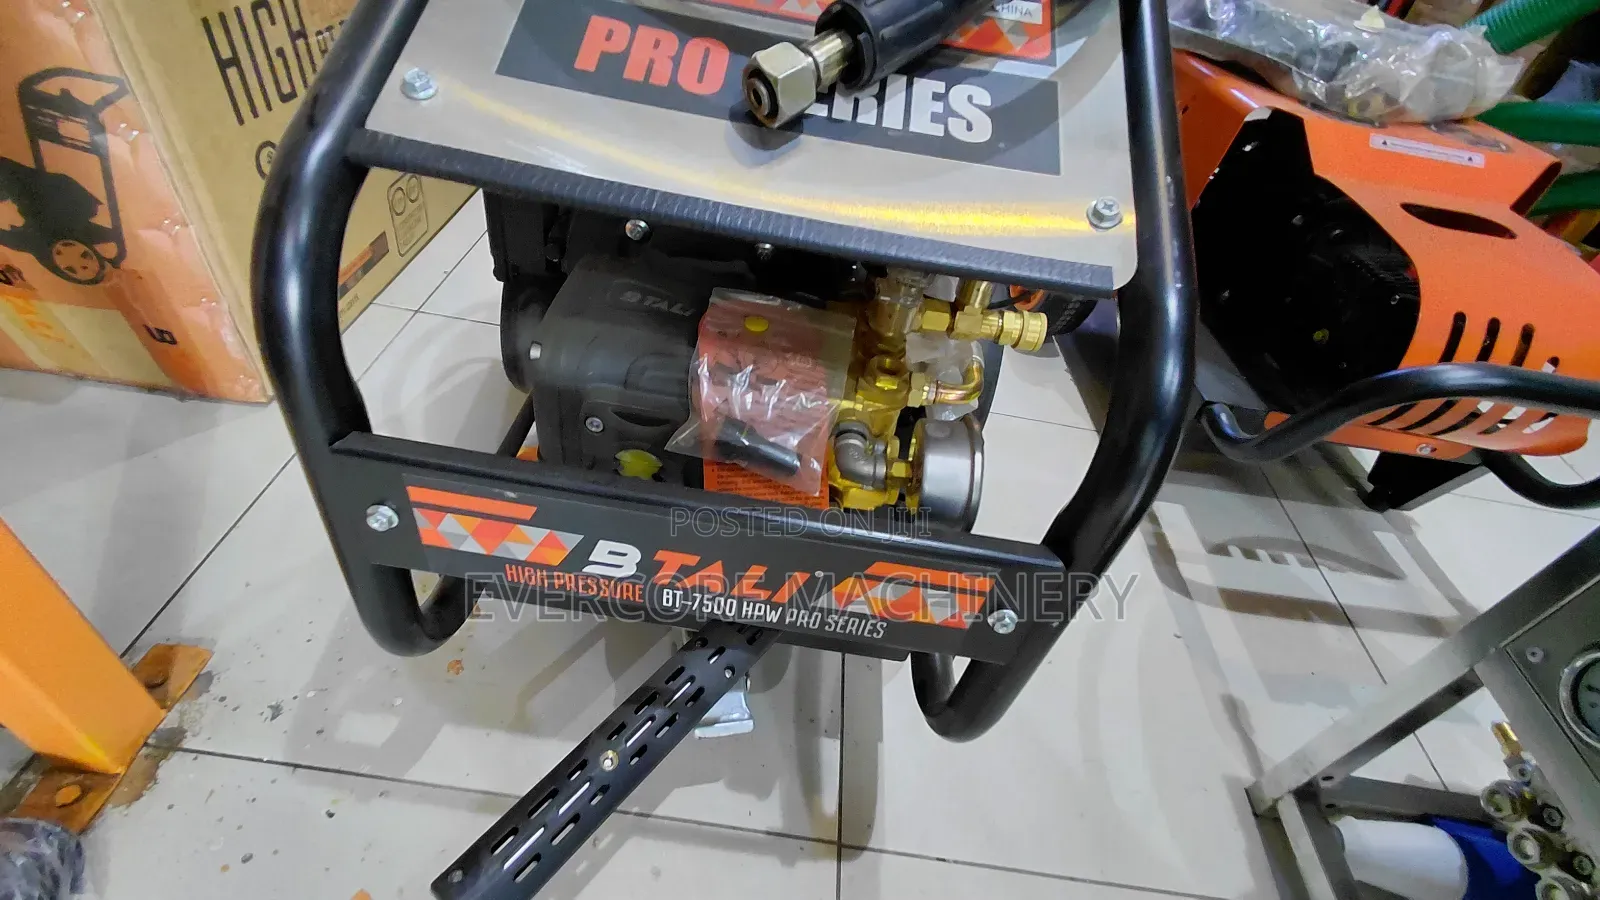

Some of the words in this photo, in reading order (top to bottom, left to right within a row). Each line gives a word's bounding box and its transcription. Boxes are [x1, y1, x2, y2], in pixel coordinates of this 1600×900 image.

[999, 4, 1033, 18] HINA
[201, 0, 317, 126] HIGH
[574, 15, 730, 95] PRO
[805, 74, 992, 143] RIES
[505, 564, 548, 588] HIGH
[554, 572, 643, 602] PRESSURE
[662, 588, 737, 617] BT-7500
[742, 603, 783, 624] HPW
[785, 608, 822, 630] PRO
[825, 615, 888, 639] SERIES
